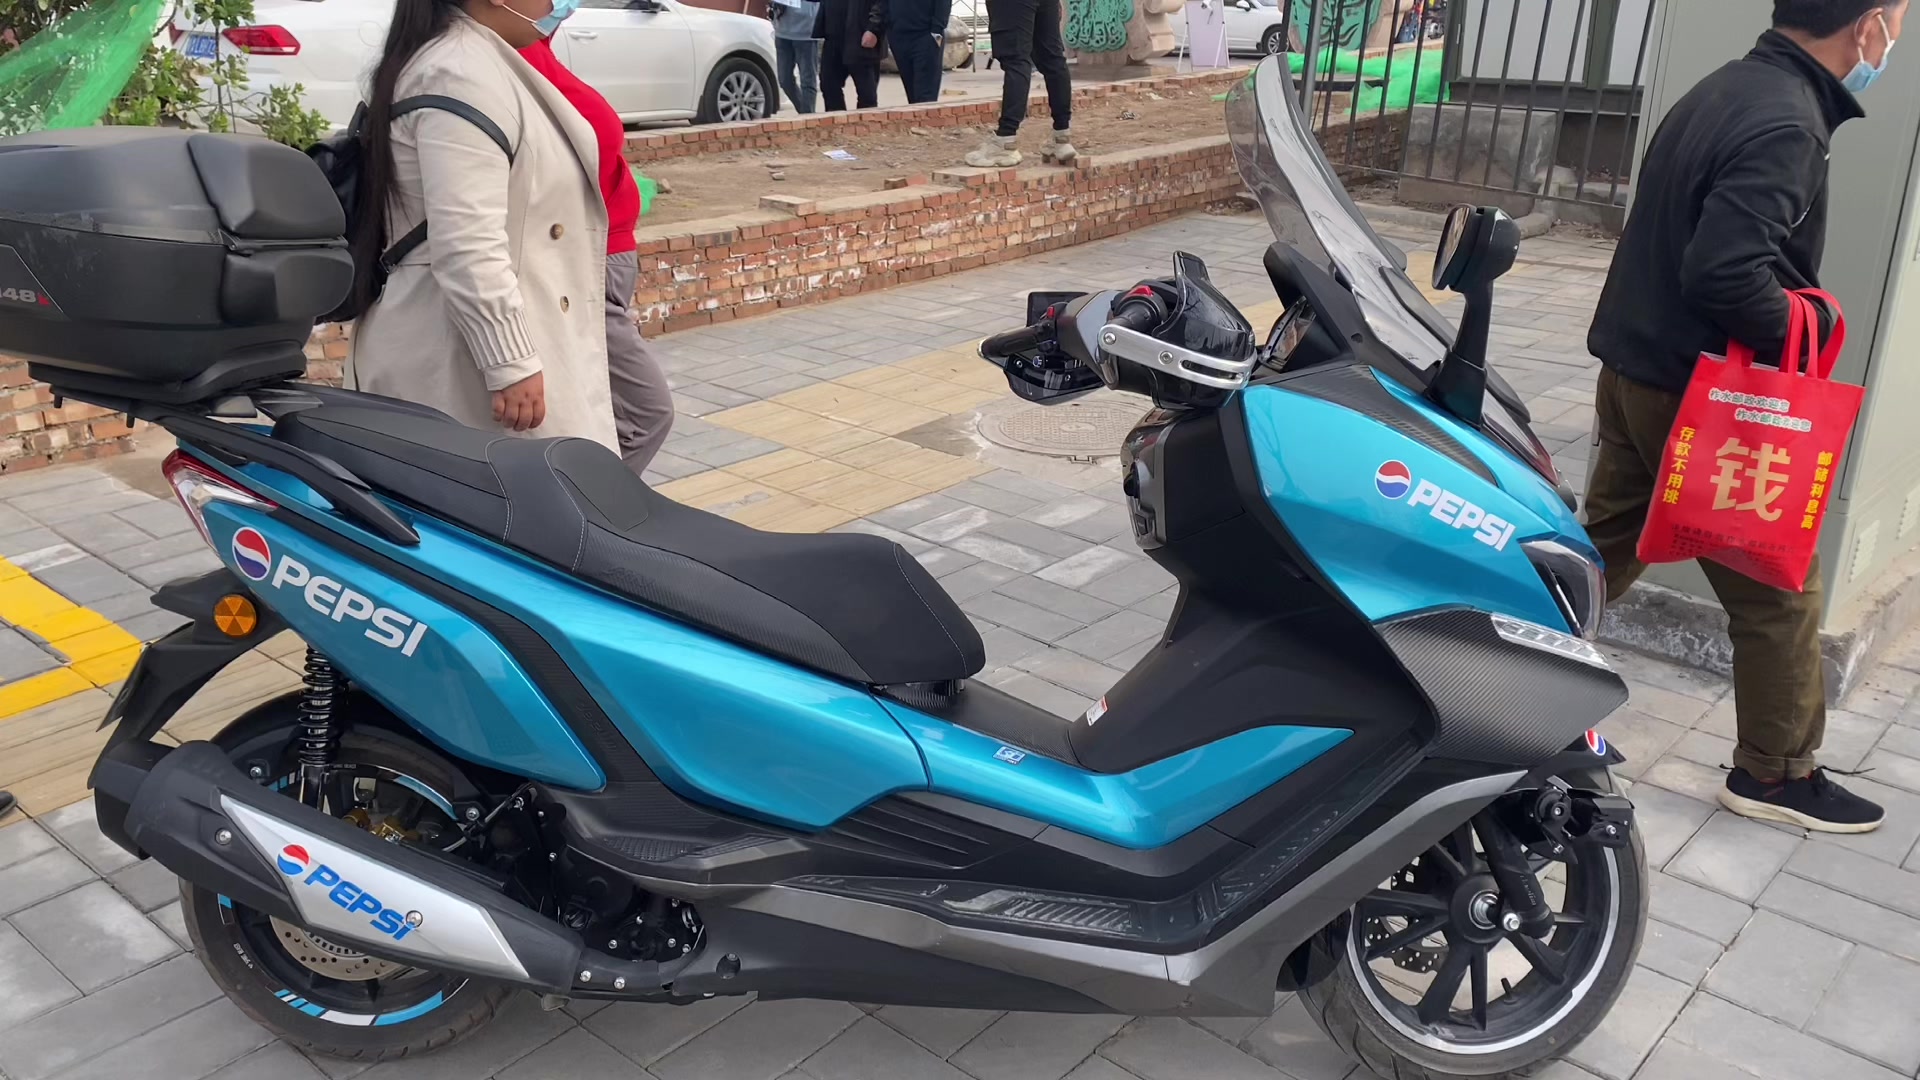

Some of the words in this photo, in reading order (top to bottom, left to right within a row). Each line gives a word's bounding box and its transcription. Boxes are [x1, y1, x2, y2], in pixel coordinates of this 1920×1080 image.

[1662, 426, 1696, 505] 存款不用挑
[1710, 437, 1791, 522] 钱
[1801, 450, 1833, 530] 邮储利息高
[1407, 478, 1516, 552] PEPSI
[271, 554, 428, 657] PEPSI
